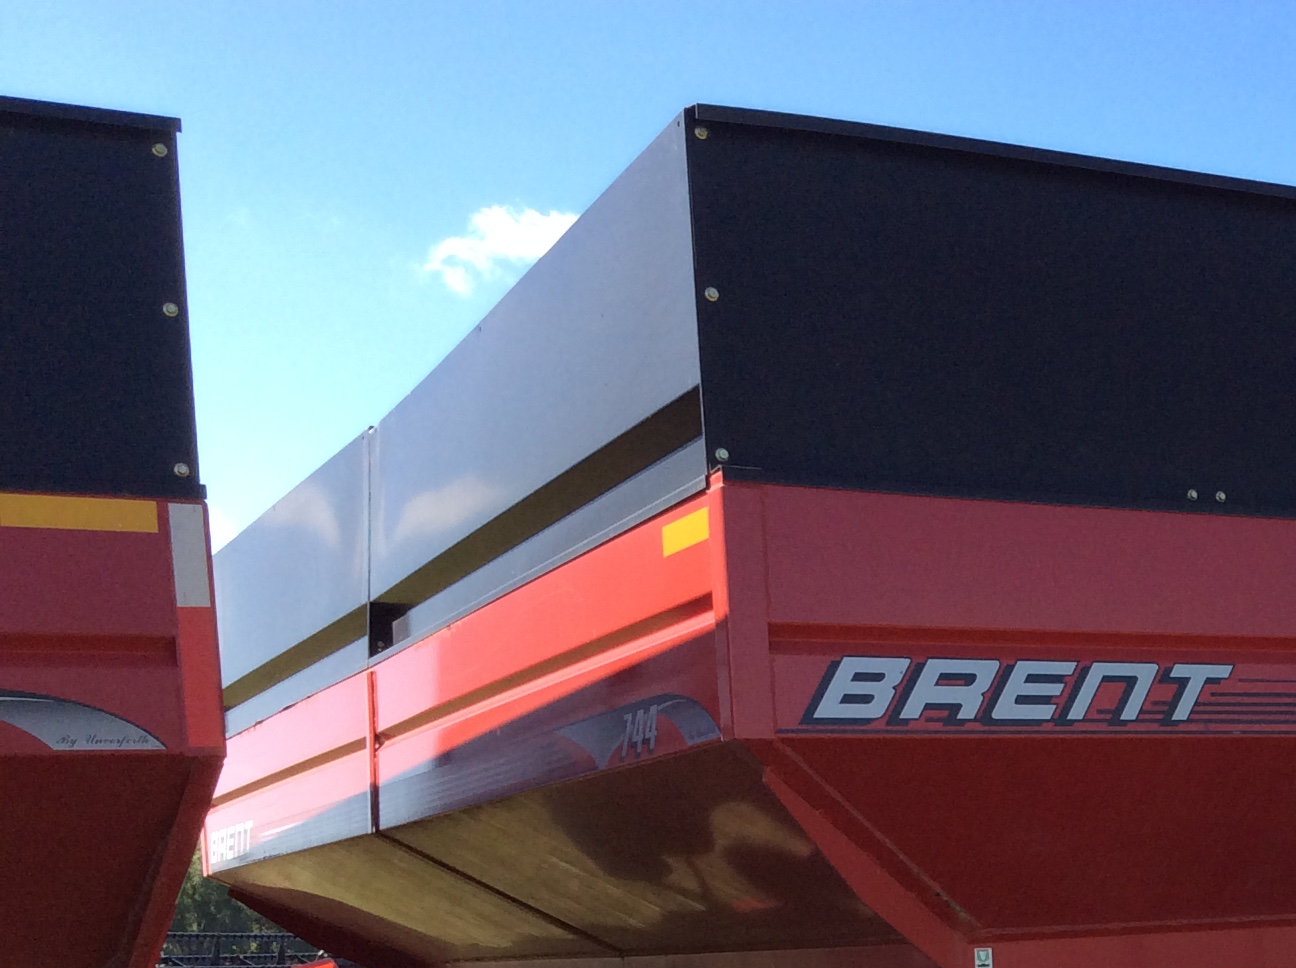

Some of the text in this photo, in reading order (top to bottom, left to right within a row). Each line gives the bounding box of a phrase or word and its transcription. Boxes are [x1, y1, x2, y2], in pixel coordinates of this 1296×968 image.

[803, 655, 1235, 724] BRENT
[620, 704, 659, 758] 744
[210, 819, 253, 864] BRENT
